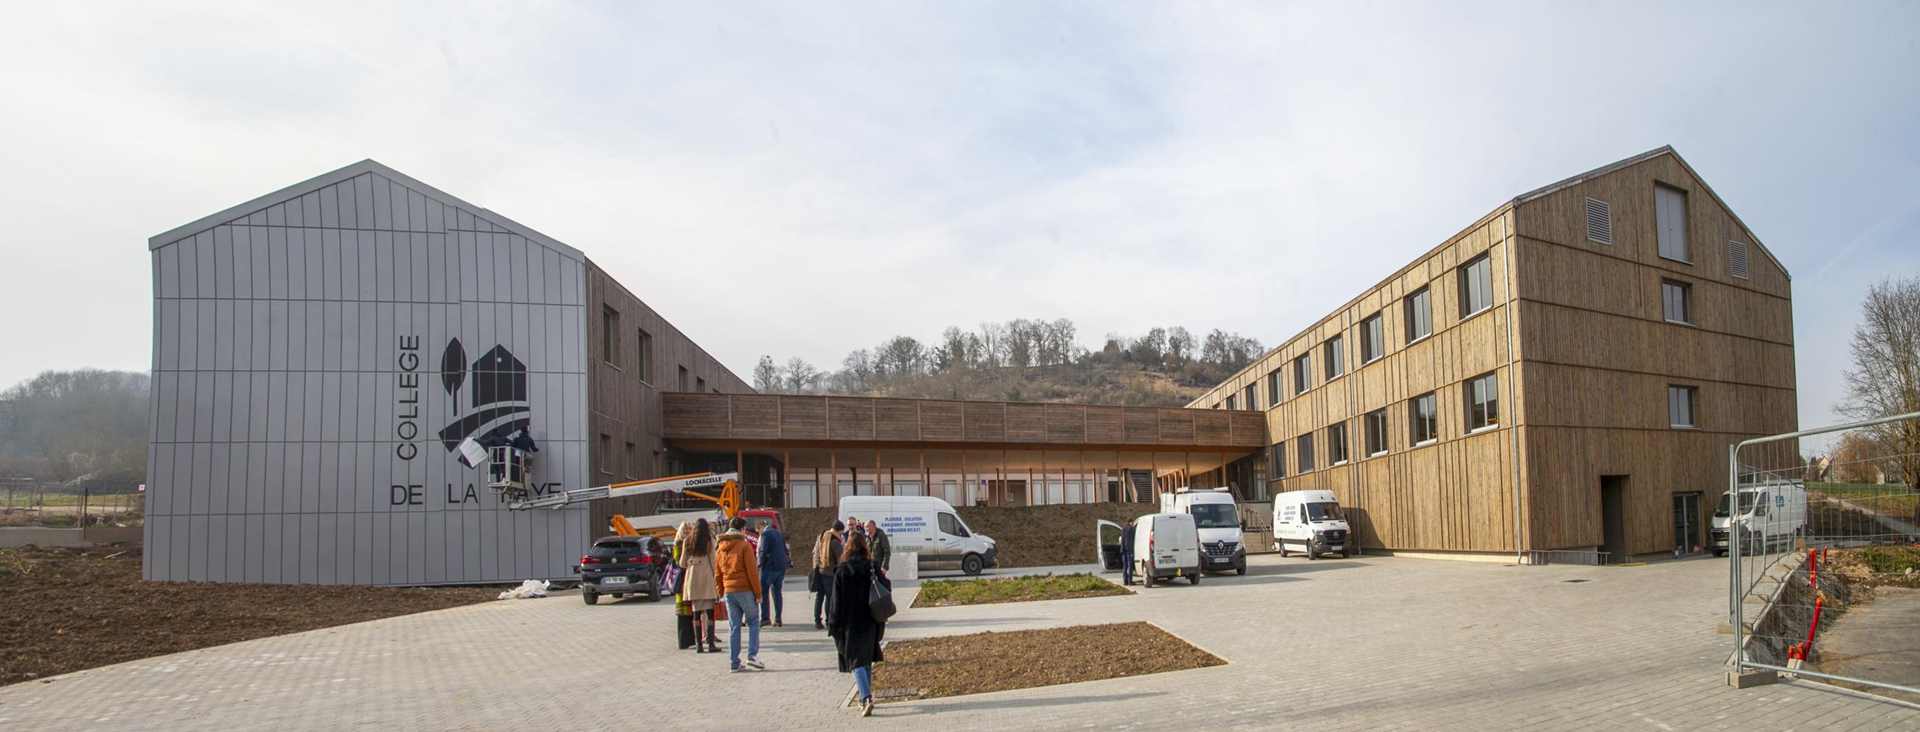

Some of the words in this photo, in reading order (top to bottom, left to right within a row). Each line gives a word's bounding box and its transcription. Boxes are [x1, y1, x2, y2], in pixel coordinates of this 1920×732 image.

[397, 335, 419, 460] COLLEGE
[391, 484, 423, 505] DE
[448, 483, 479, 504] LA
